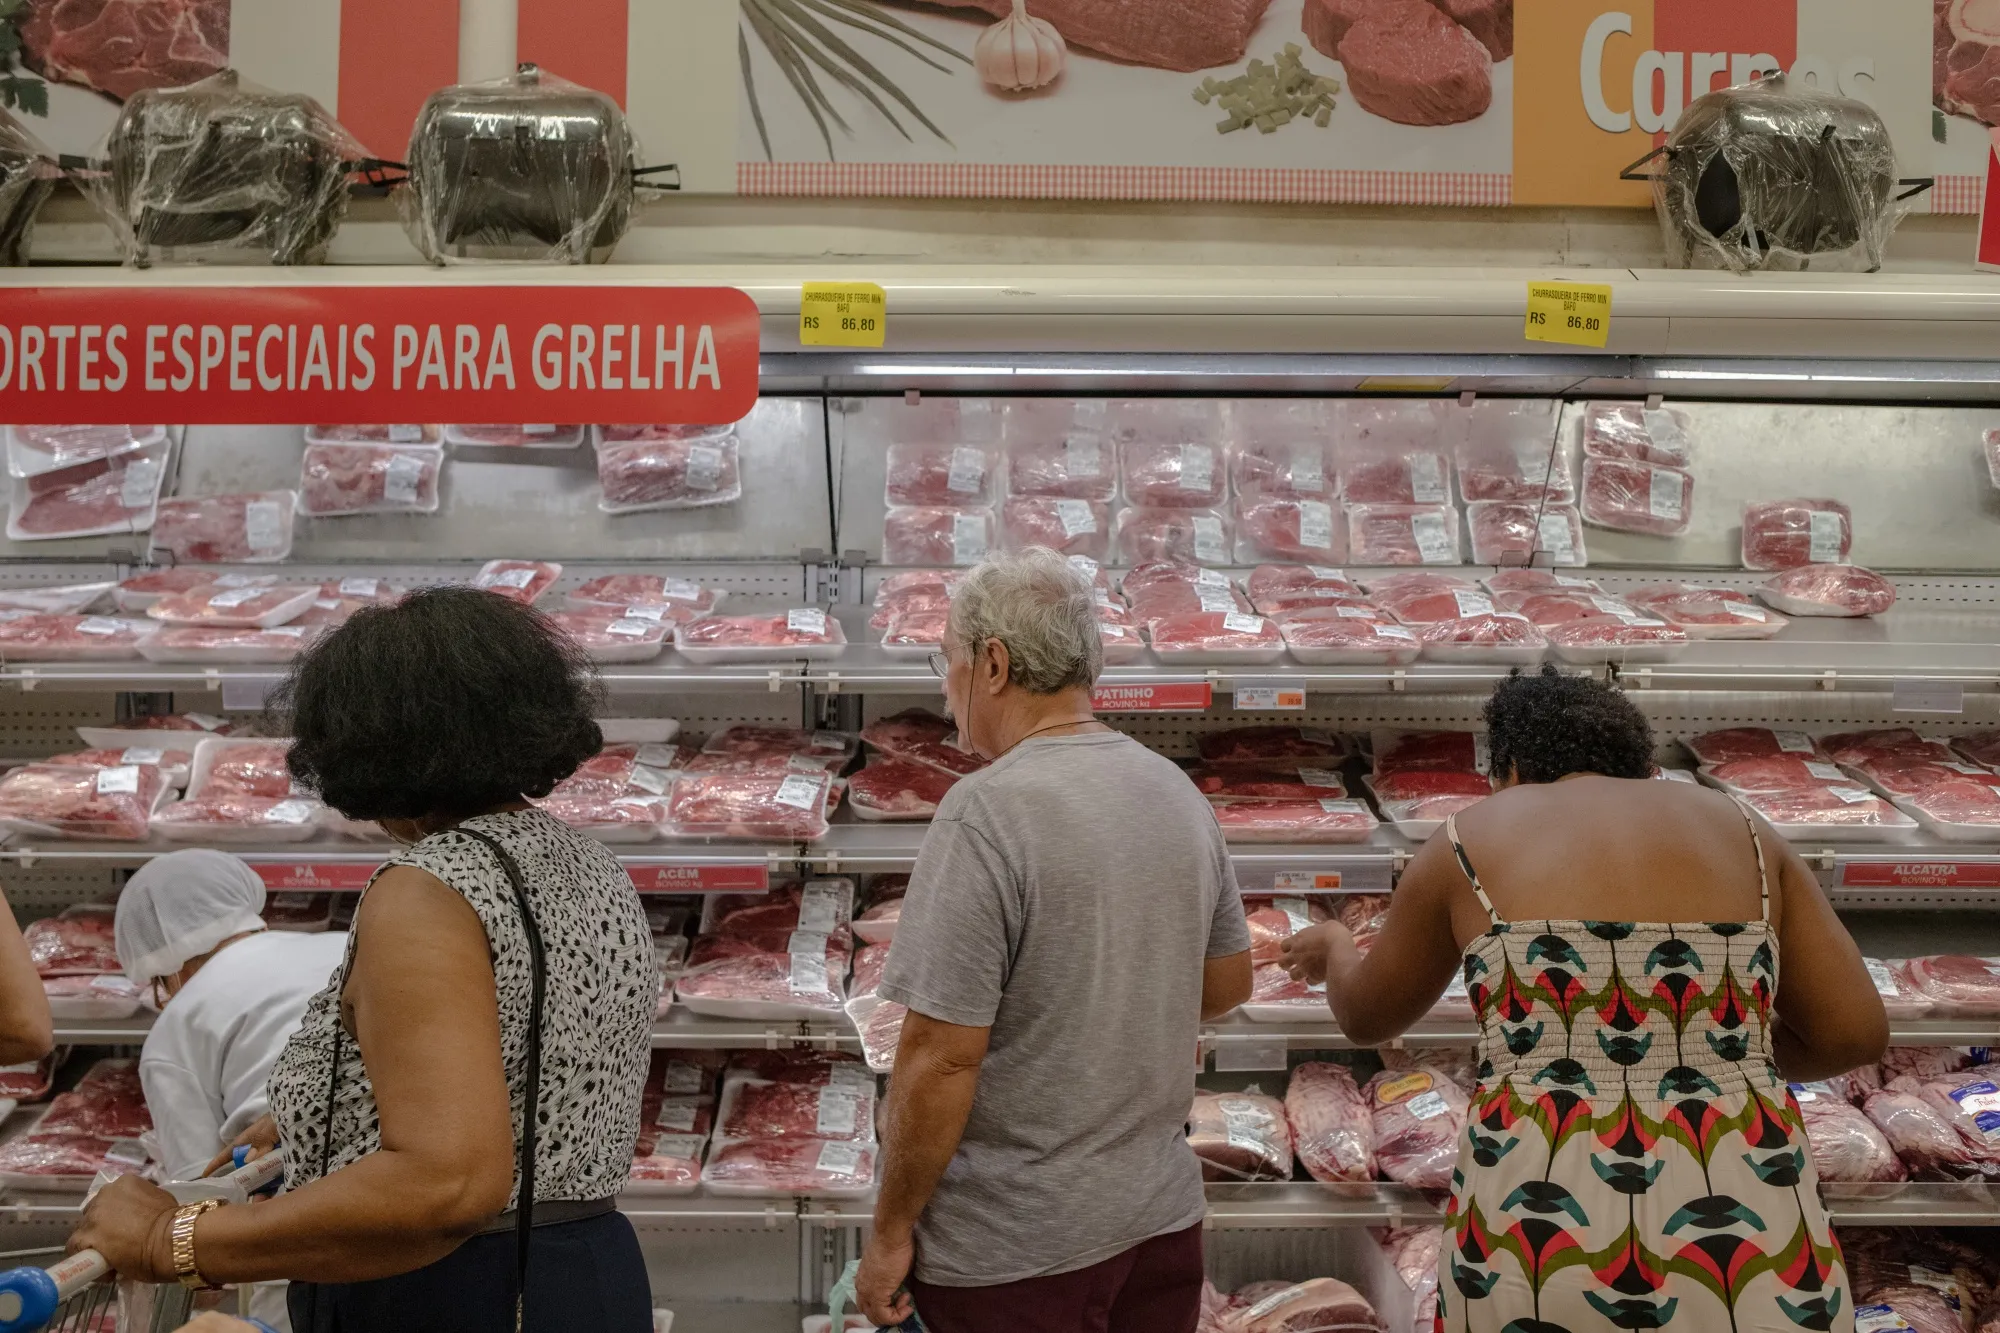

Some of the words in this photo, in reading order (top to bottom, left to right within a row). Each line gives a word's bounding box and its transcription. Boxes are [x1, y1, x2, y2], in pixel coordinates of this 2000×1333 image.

[805, 292, 845, 303] CHURRASQUEIRA
[846, 293, 853, 303] DE
[854, 293, 870, 304] FERRO
[1532, 288, 1572, 300] CHURRASQUEIRA
[1572, 291, 1580, 302] DE
[1580, 292, 1597, 303] FERRO
[1597, 294, 1607, 304] MIN
[836, 303, 850, 313] BAFO
[1563, 301, 1576, 312] BAFO
[841, 318, 875, 332] 86,80
[1567, 315, 1600, 331] 86,80
[145, 323, 376, 392] ESPECIAIS
[392, 323, 516, 391] PARA
[532, 323, 721, 391] GRELHA
[1095, 687, 1154, 700] PATINHO
[1103, 700, 1138, 709] BOVINO
[657, 867, 699, 880] ACÉM
[1893, 863, 1957, 876] ALCATRA
[655, 880, 691, 888] BOVINO
[1901, 876, 1936, 884] BOVINO
[1937, 876, 1947, 886] kg
